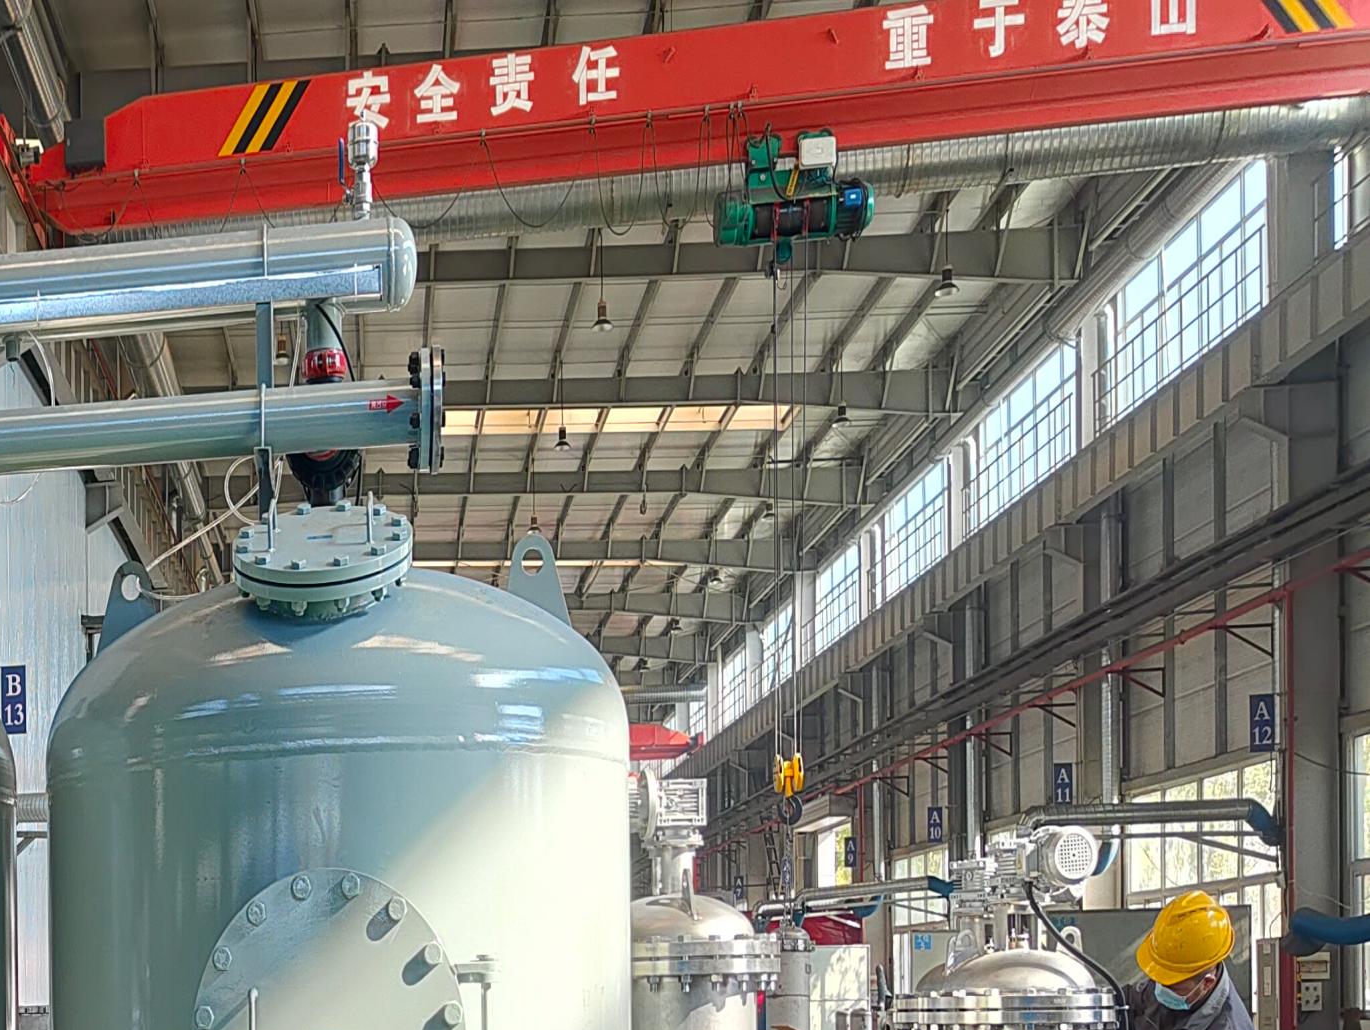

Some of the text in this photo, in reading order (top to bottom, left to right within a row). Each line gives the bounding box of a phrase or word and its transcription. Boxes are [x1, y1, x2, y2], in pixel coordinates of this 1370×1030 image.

[346, 0, 1197, 129] 安全责任 重于泰山
[5, 673, 22, 697] B
[4, 703, 25, 726] 13
[1254, 701, 1271, 720] A
[1252, 726, 1272, 745] 12
[1056, 768, 1071, 783] A
[1056, 787, 1071, 803] 11
[930, 811, 941, 824] A
[929, 826, 942, 839] 10
[847, 840, 856, 851] A
[847, 853, 855, 864] 9
